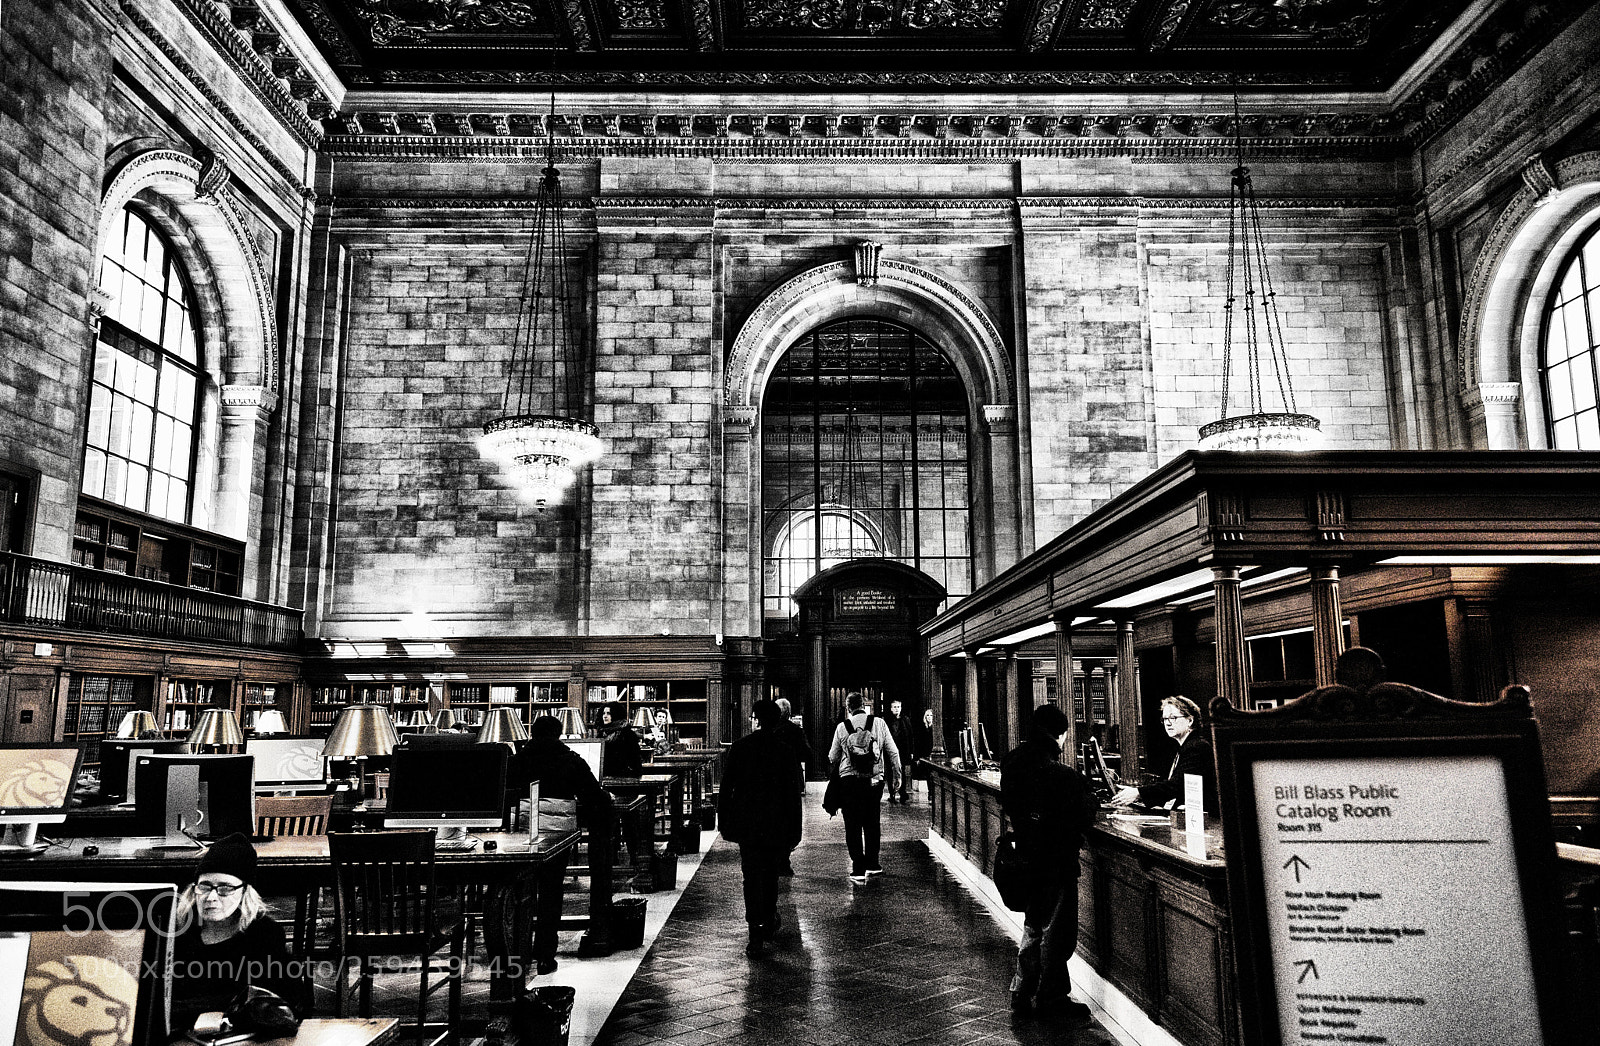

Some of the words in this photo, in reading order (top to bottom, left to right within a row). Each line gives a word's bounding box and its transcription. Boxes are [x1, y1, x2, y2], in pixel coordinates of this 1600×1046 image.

[1274, 785, 1298, 800] Bill
[1304, 785, 1344, 800] Blass
[1349, 784, 1399, 800] Public
[1276, 803, 1338, 822] Catalog
[1343, 803, 1391, 818] Room
[1277, 823, 1305, 832] Room
